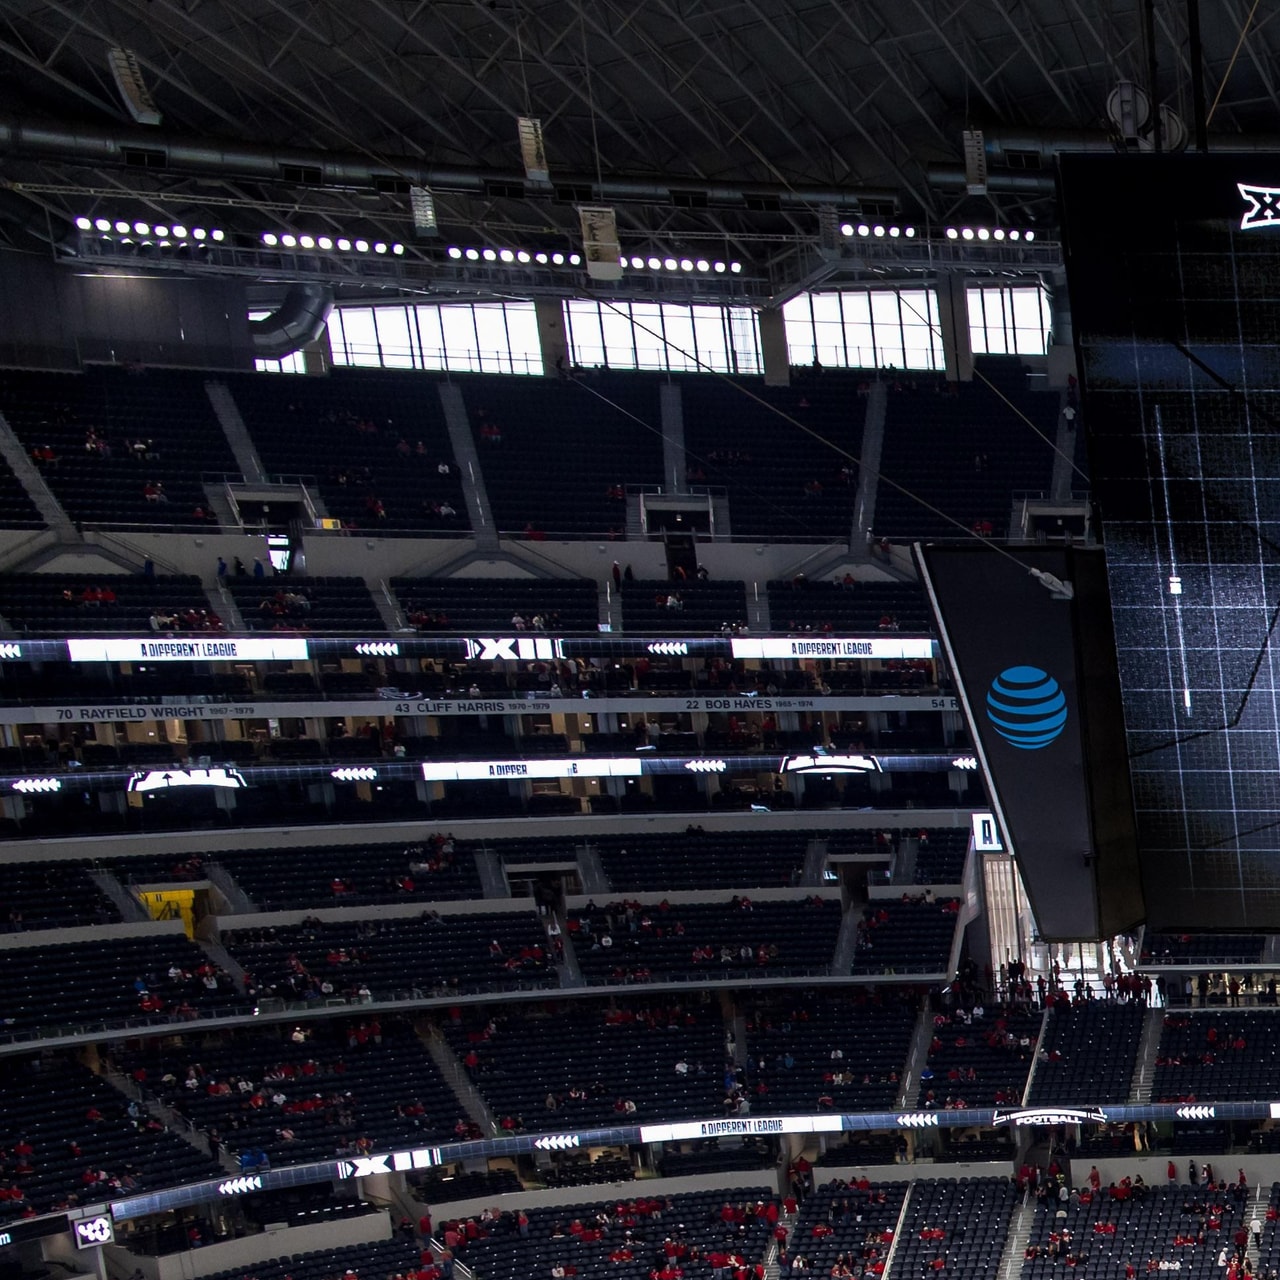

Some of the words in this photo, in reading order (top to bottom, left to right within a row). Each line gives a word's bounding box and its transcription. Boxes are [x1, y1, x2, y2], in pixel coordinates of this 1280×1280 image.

[141, 643, 148, 657] A
[149, 643, 201, 657] DIFFERENT
[202, 643, 238, 657] LEAGUE
[792, 643, 798, 655] A
[799, 643, 842, 655] DIFFERENT
[843, 643, 873, 655] LEAGUE
[395, 703, 410, 713] 43
[417, 703, 453, 713] CLIFF
[457, 702, 505, 712] HARRIS
[686, 700, 699, 709] 22
[705, 700, 731, 709] BOB
[734, 700, 772, 709] HAYES
[56, 709, 73, 720] 70
[80, 708, 148, 720] RAYFIELD
[150, 707, 204, 719] WRIGHT
[1016, 1115, 1082, 1125] FOOTBALL
[701, 1122, 708, 1136] A
[708, 1120, 752, 1135] DIFFERENT
[754, 1119, 783, 1133] LEAGUE
